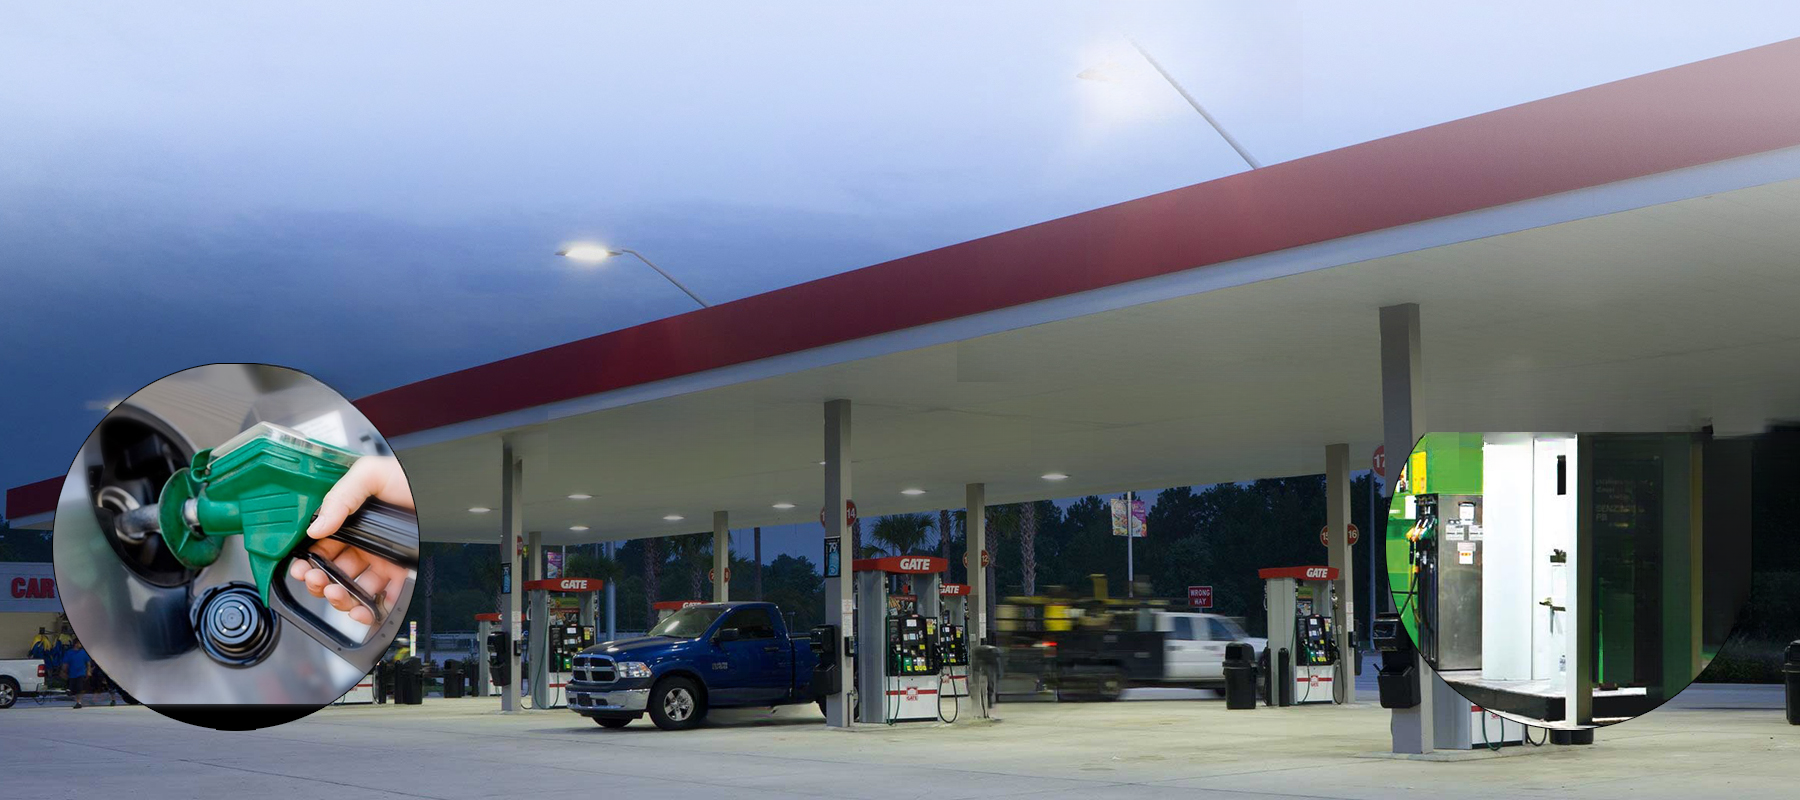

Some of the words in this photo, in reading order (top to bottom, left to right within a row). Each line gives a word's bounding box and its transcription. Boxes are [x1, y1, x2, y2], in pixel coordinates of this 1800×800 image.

[846, 508, 856, 519] 14
[1348, 529, 1357, 539] 16
[900, 558, 930, 571] GATE
[1306, 567, 1328, 578] GATE
[11, 576, 55, 599] CAR
[560, 579, 588, 590] GATE
[1190, 589, 1210, 597] WRONG
